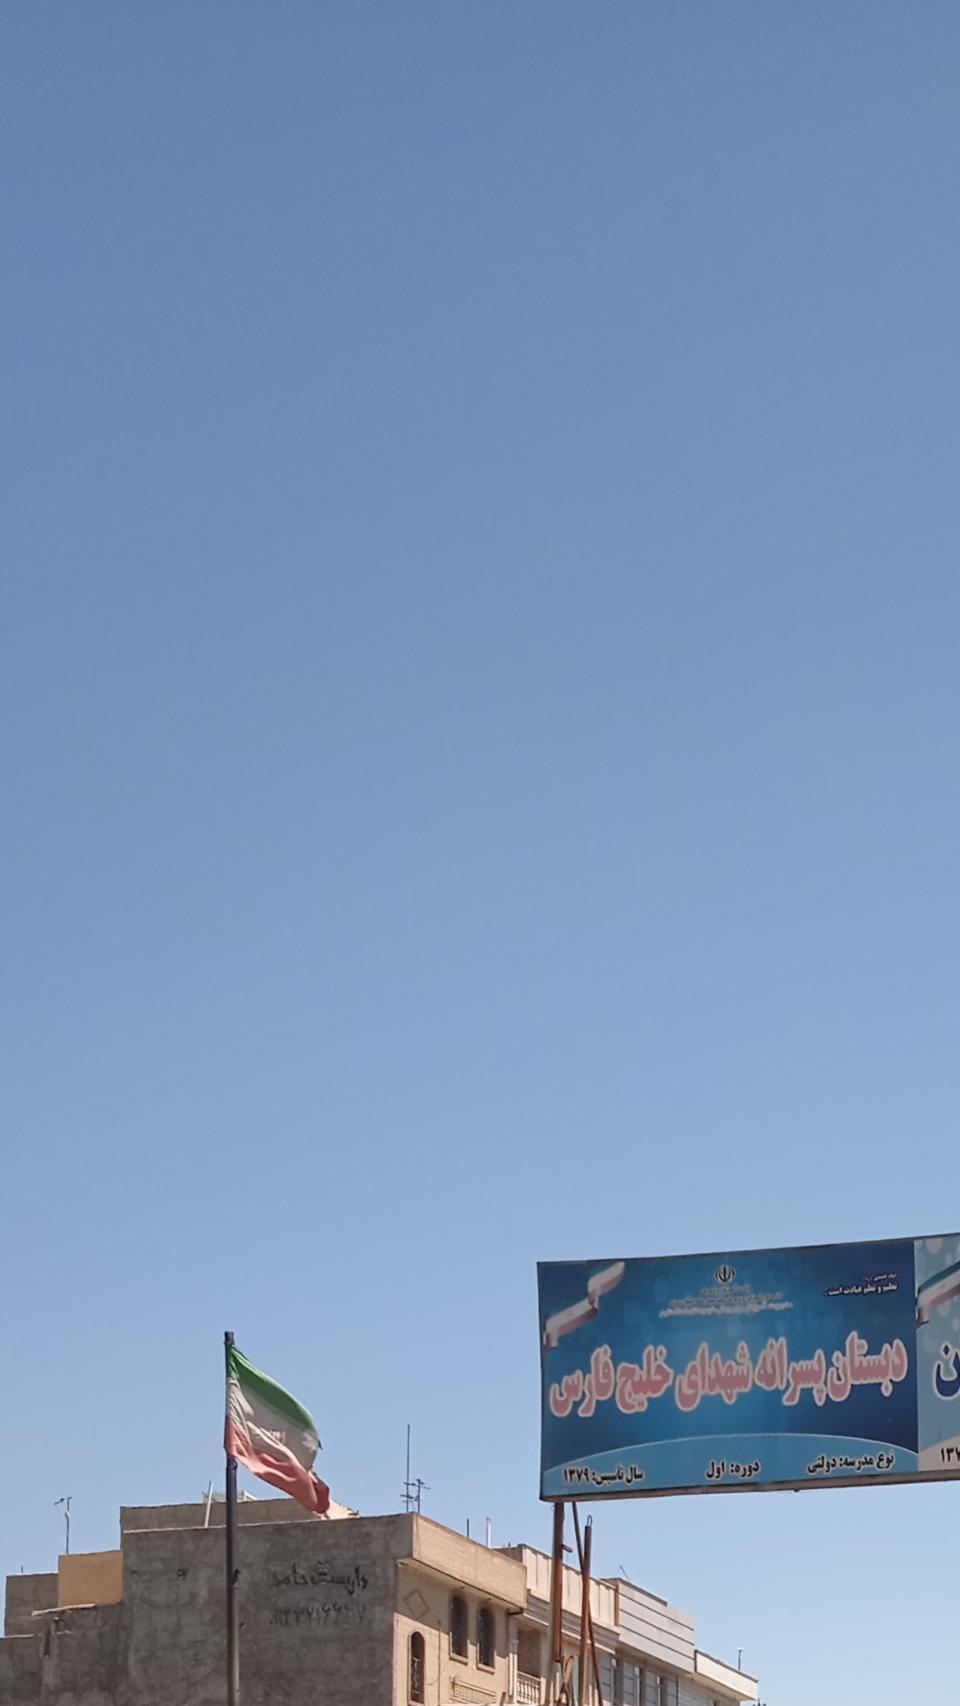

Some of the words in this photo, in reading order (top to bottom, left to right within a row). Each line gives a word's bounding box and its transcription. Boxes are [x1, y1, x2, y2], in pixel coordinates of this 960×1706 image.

[550, 1343, 615, 1418] فارس
[615, 1343, 674, 1414] خلیج
[676, 1342, 752, 1412] شهدای
[755, 1337, 826, 1406] پسرانه
[827, 1330, 908, 1402] دبستان
[563, 1467, 590, 1484] ۱۳۷۹
[626, 1465, 644, 1485] سال
[706, 1461, 726, 1480] اول
[730, 1460, 760, 1479] دوره:
[876, 1451, 895, 1469] نوع
